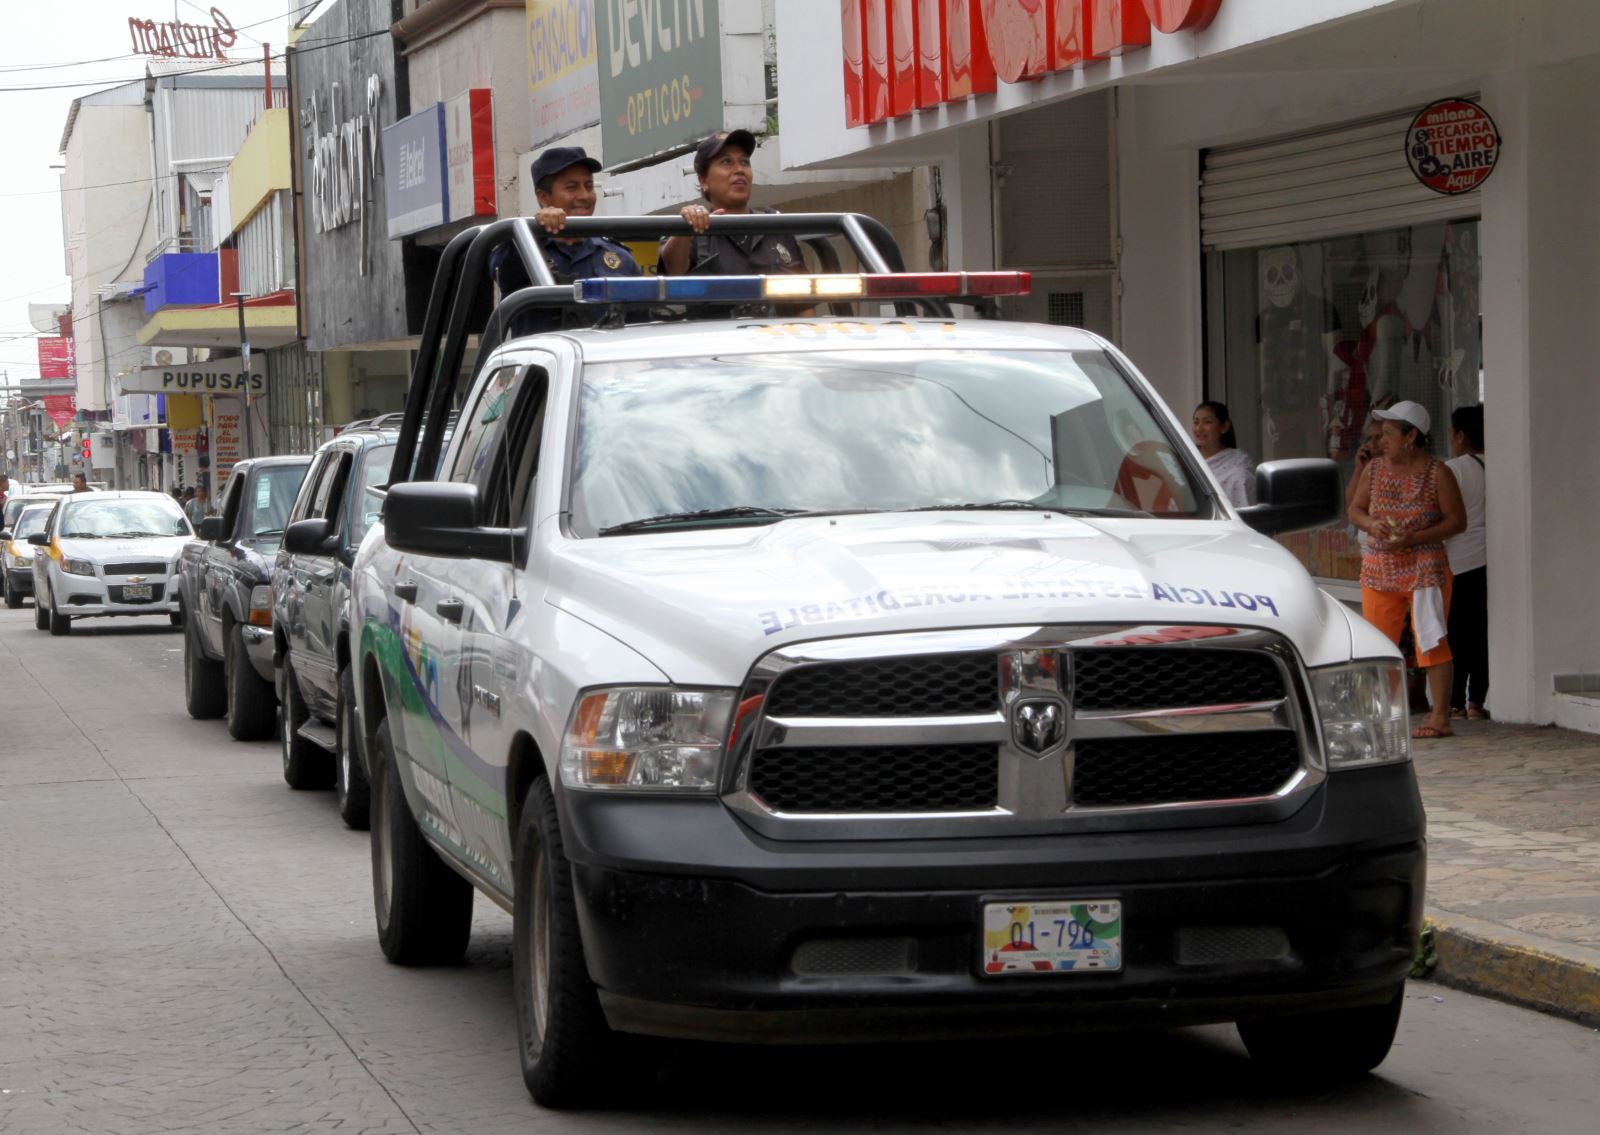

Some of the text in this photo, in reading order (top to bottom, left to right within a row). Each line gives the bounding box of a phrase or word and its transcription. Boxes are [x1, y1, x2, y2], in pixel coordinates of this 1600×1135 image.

[627, 73, 692, 136] OPTICOS
[1427, 108, 1476, 125] milano
[1427, 120, 1491, 140] RECARGA
[1428, 133, 1496, 156] TIEMPO
[1452, 149, 1493, 171] AIRE
[1446, 169, 1478, 189] Aquí
[163, 371, 263, 389] PUPUSAS
[1011, 919, 1094, 949] 01-796
